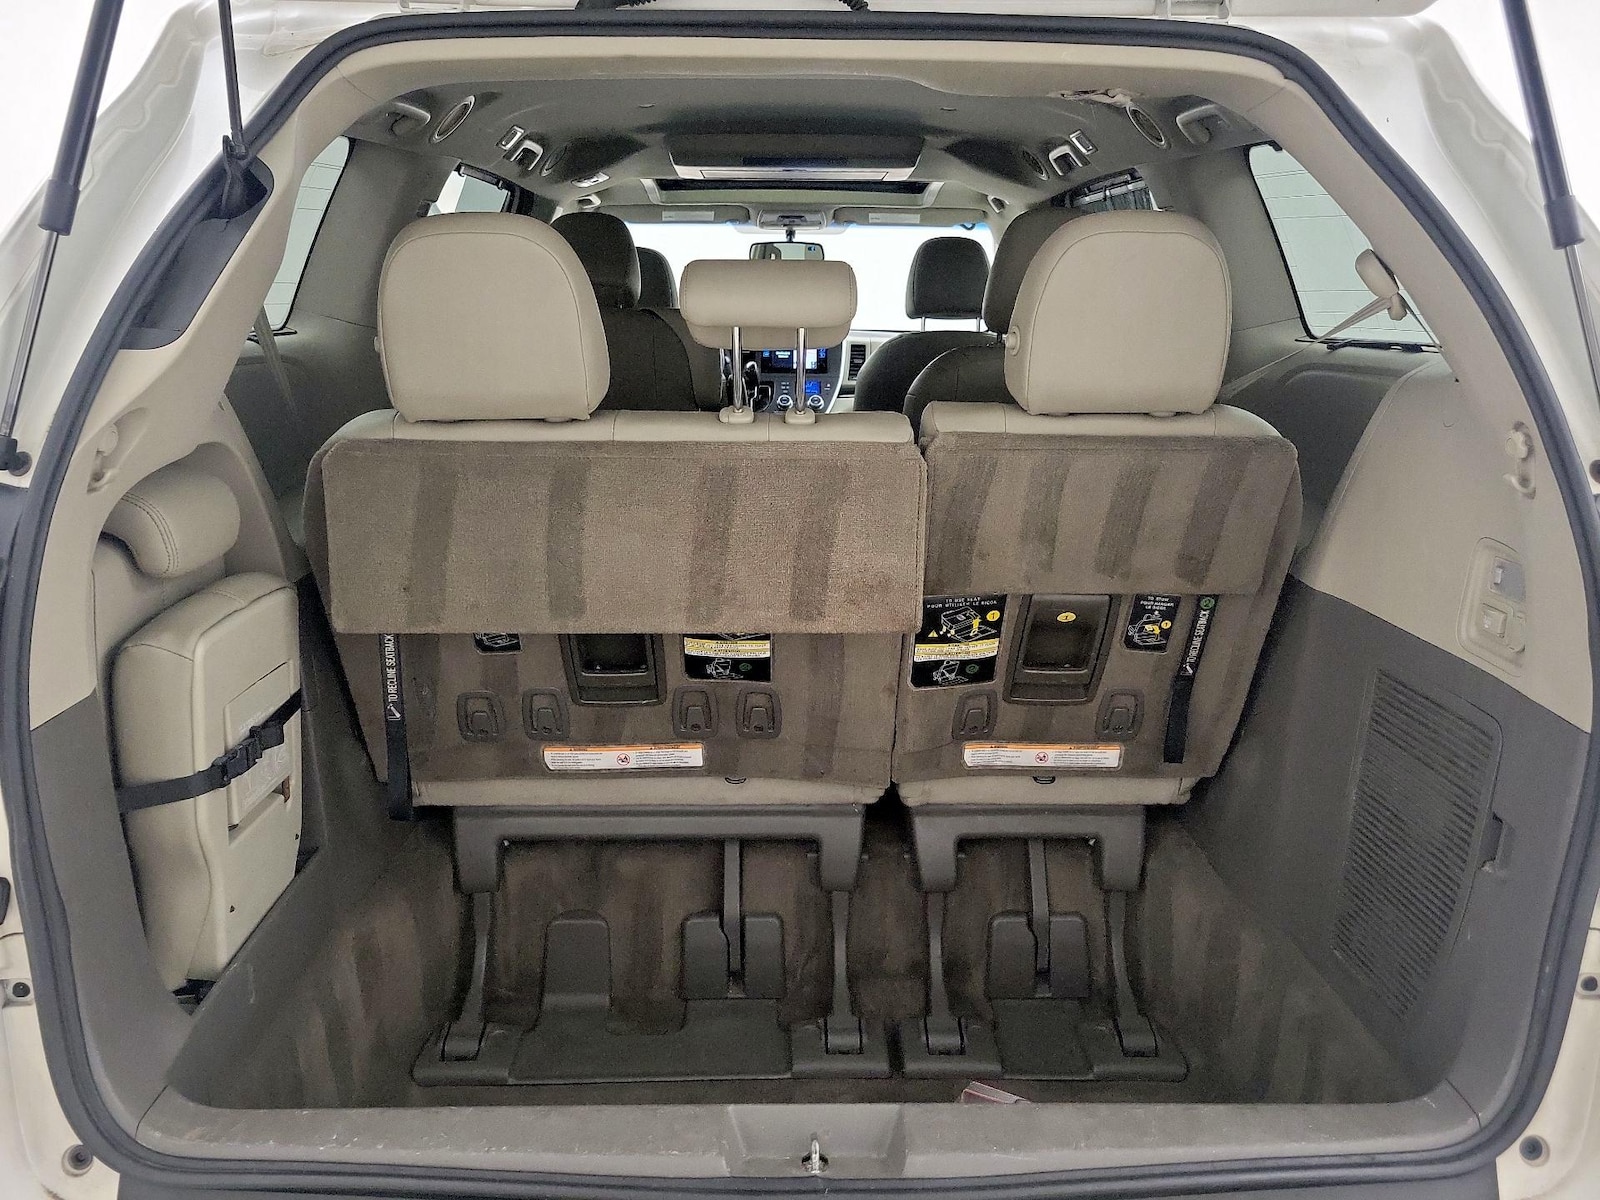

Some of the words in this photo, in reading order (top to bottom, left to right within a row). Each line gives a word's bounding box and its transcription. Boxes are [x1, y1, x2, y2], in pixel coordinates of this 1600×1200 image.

[1194, 610, 1210, 636] SEATBACK
[384, 634, 396, 667] SEATBACK
[386, 667, 398, 694] RECLINE
